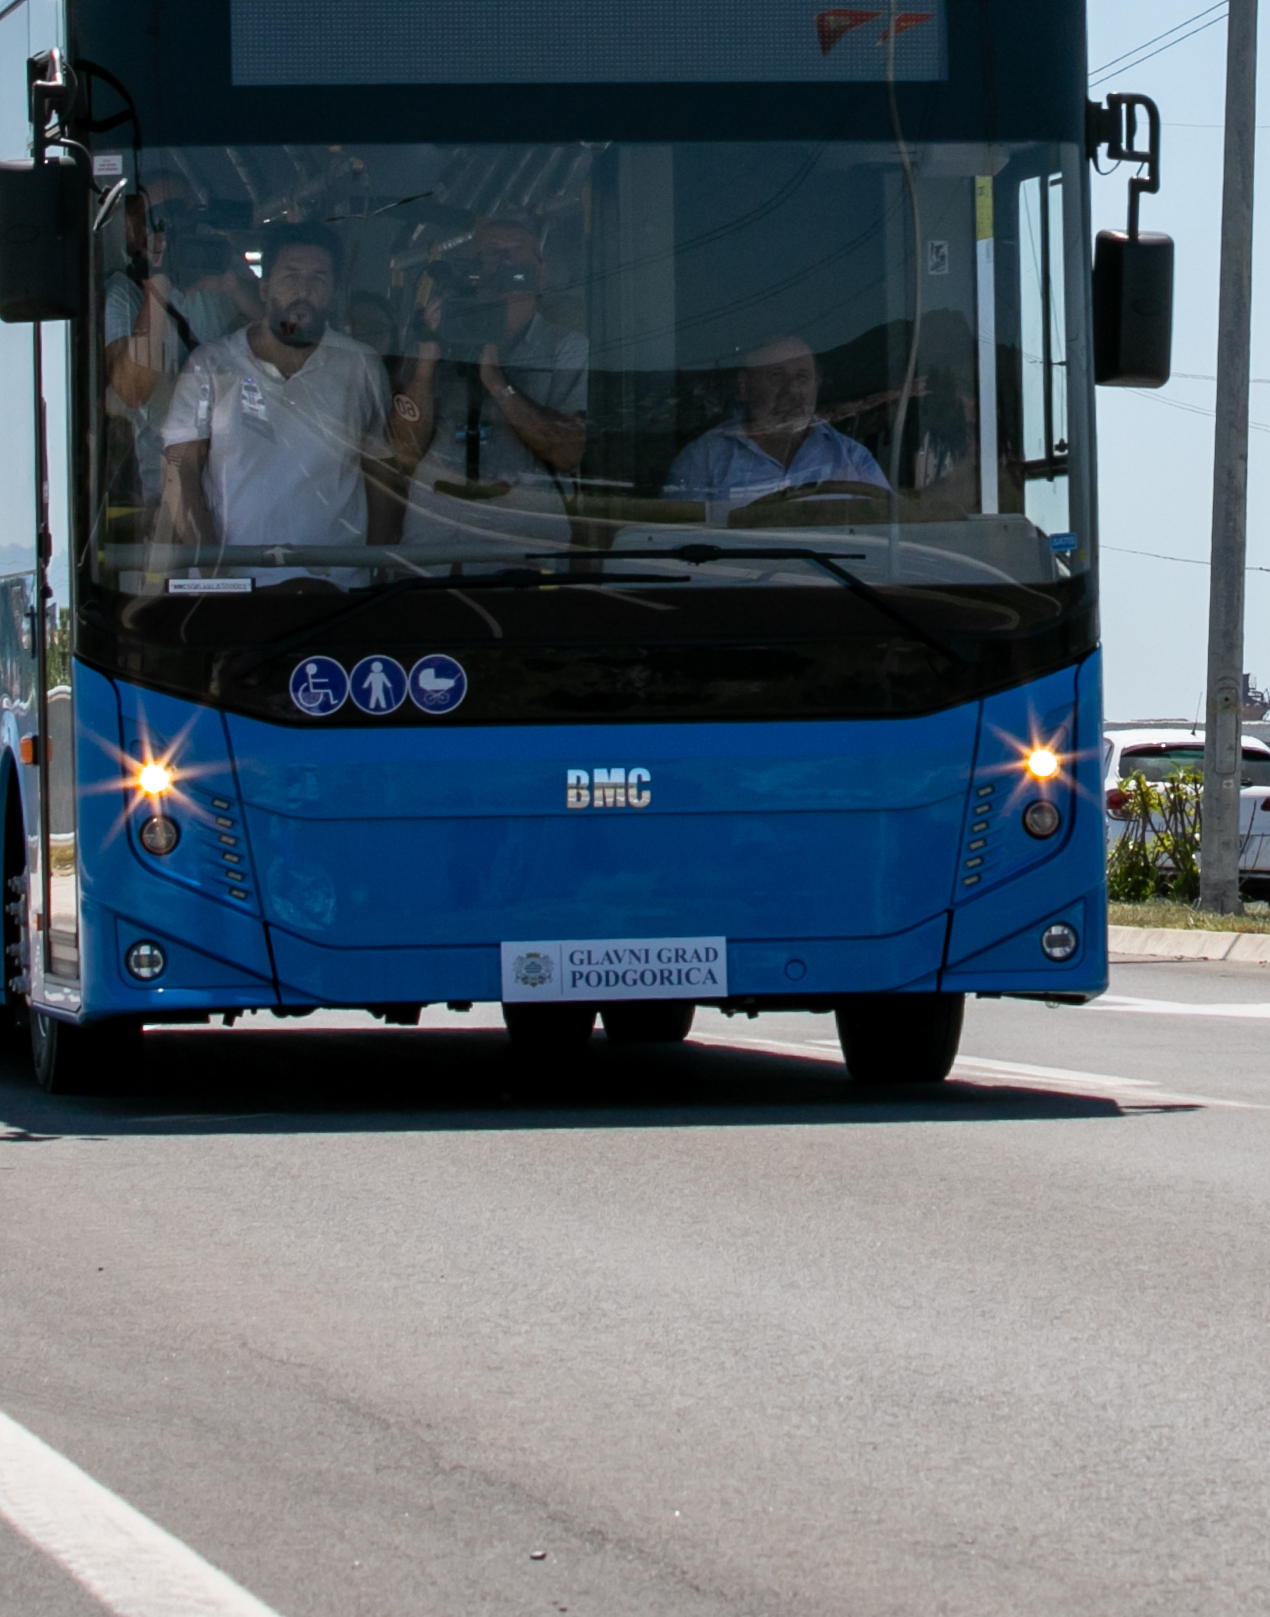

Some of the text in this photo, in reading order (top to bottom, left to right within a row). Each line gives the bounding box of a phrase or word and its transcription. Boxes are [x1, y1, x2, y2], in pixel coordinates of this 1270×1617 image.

[566, 767, 651, 809] BMC
[568, 946, 719, 966] GLAVNI GRAD
[570, 967, 719, 988] PODGORICA
